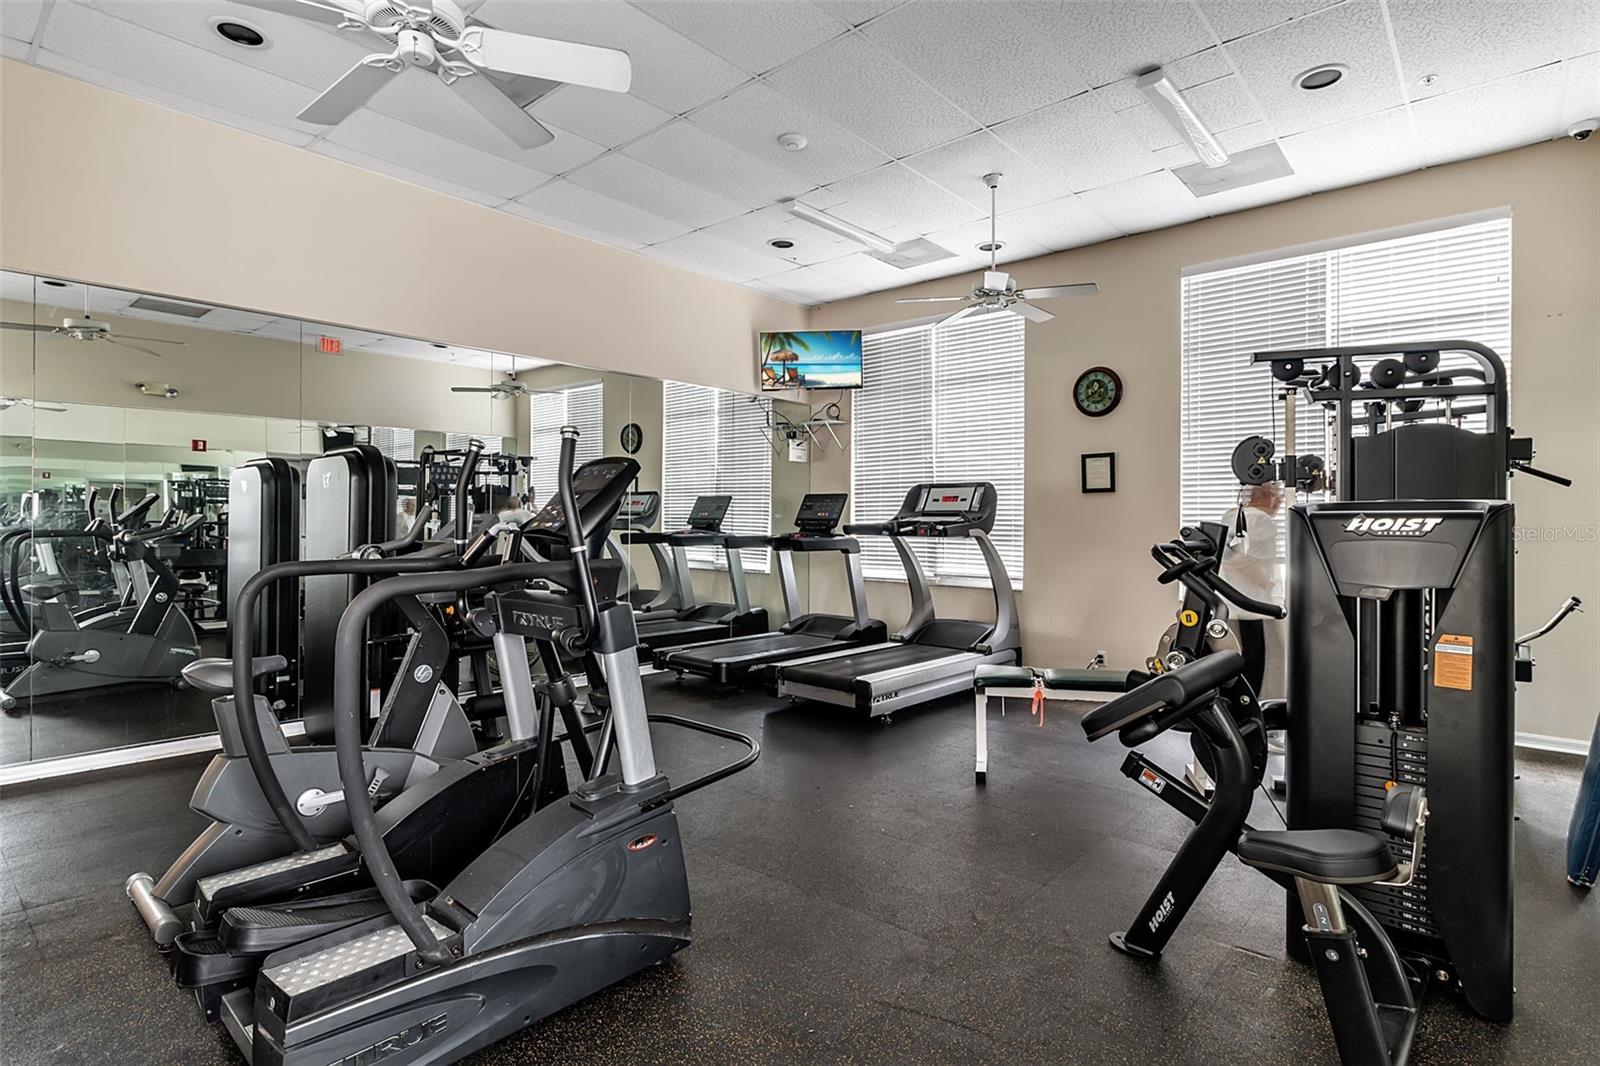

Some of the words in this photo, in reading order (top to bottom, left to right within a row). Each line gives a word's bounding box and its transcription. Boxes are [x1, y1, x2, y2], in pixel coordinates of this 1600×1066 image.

[1345, 518, 1443, 531] HOIST
[1148, 890, 1175, 933] HOIST
[1320, 917, 1327, 925] 2
[1330, 952, 1337, 960] 5
[345, 1012, 448, 1066] TRUE
